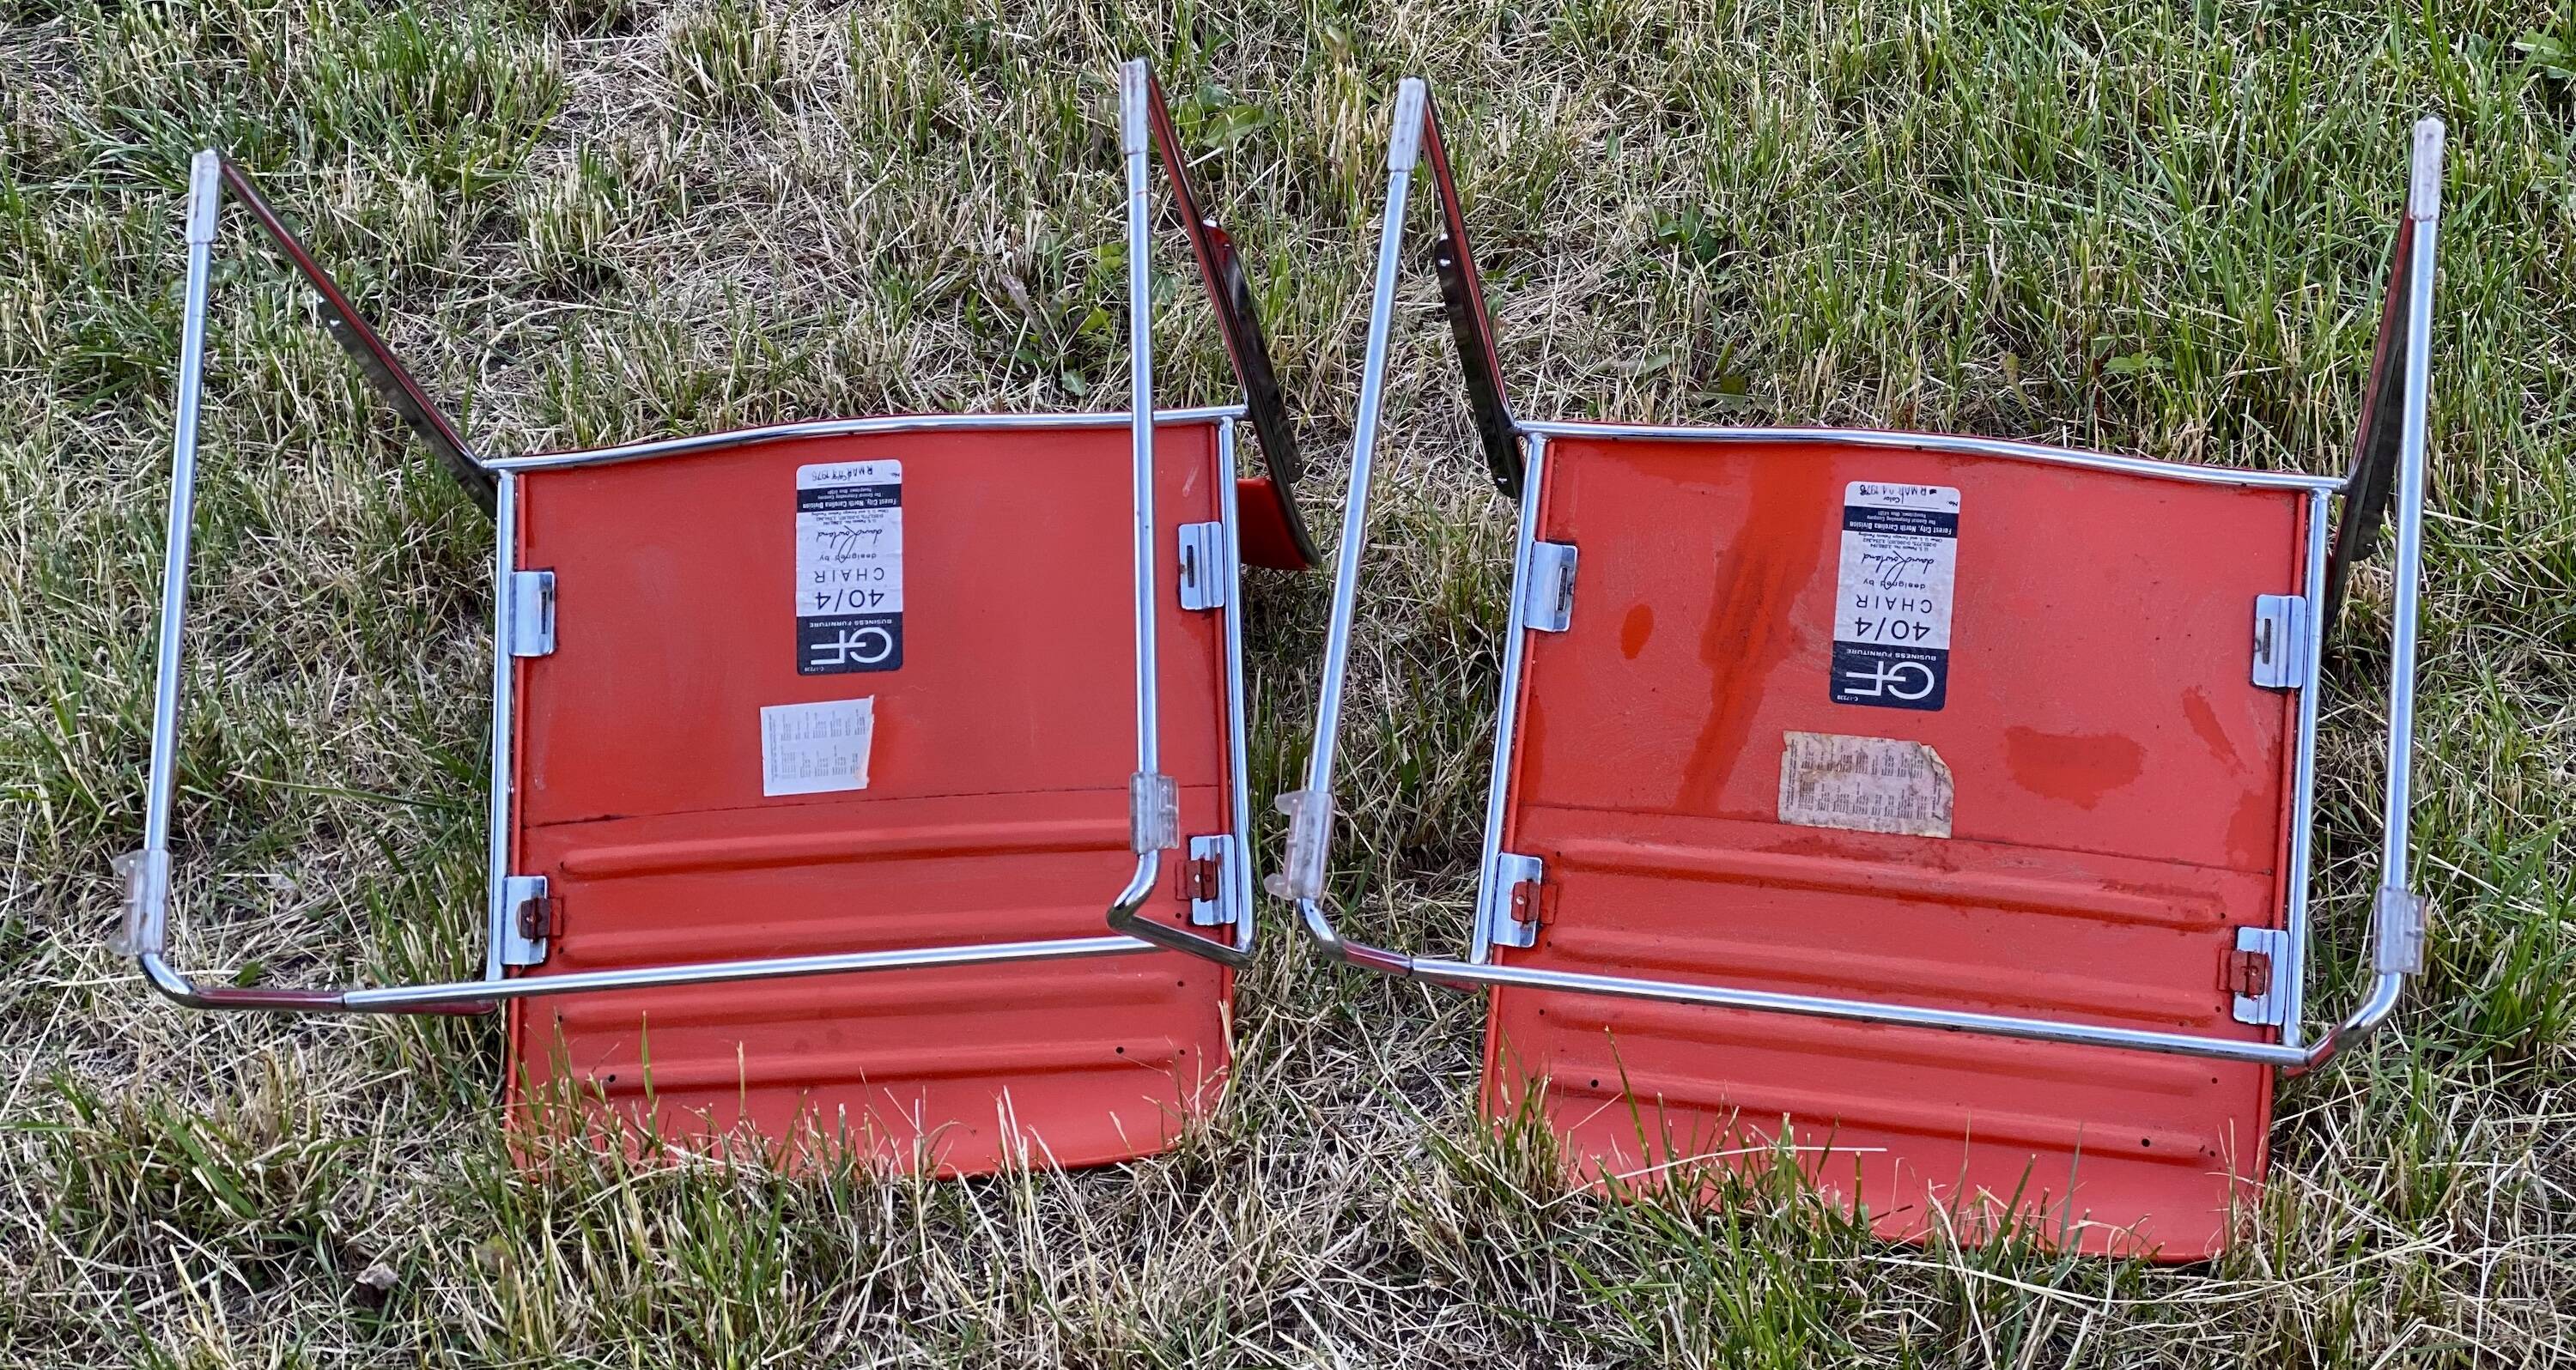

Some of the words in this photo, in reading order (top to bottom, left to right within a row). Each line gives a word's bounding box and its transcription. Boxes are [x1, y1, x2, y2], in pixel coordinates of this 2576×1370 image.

[1849, 521, 1872, 531] Division
[814, 567, 884, 583] CHAIR
[1880, 580, 1925, 589] designed
[815, 589, 884, 612] 40/4
[1856, 595, 1932, 613] CHAIR
[1855, 617, 1930, 641] 40/4
[811, 627, 892, 664] GF
[1895, 652, 1936, 661] BUSINESS
[1844, 660, 1934, 700] GF
